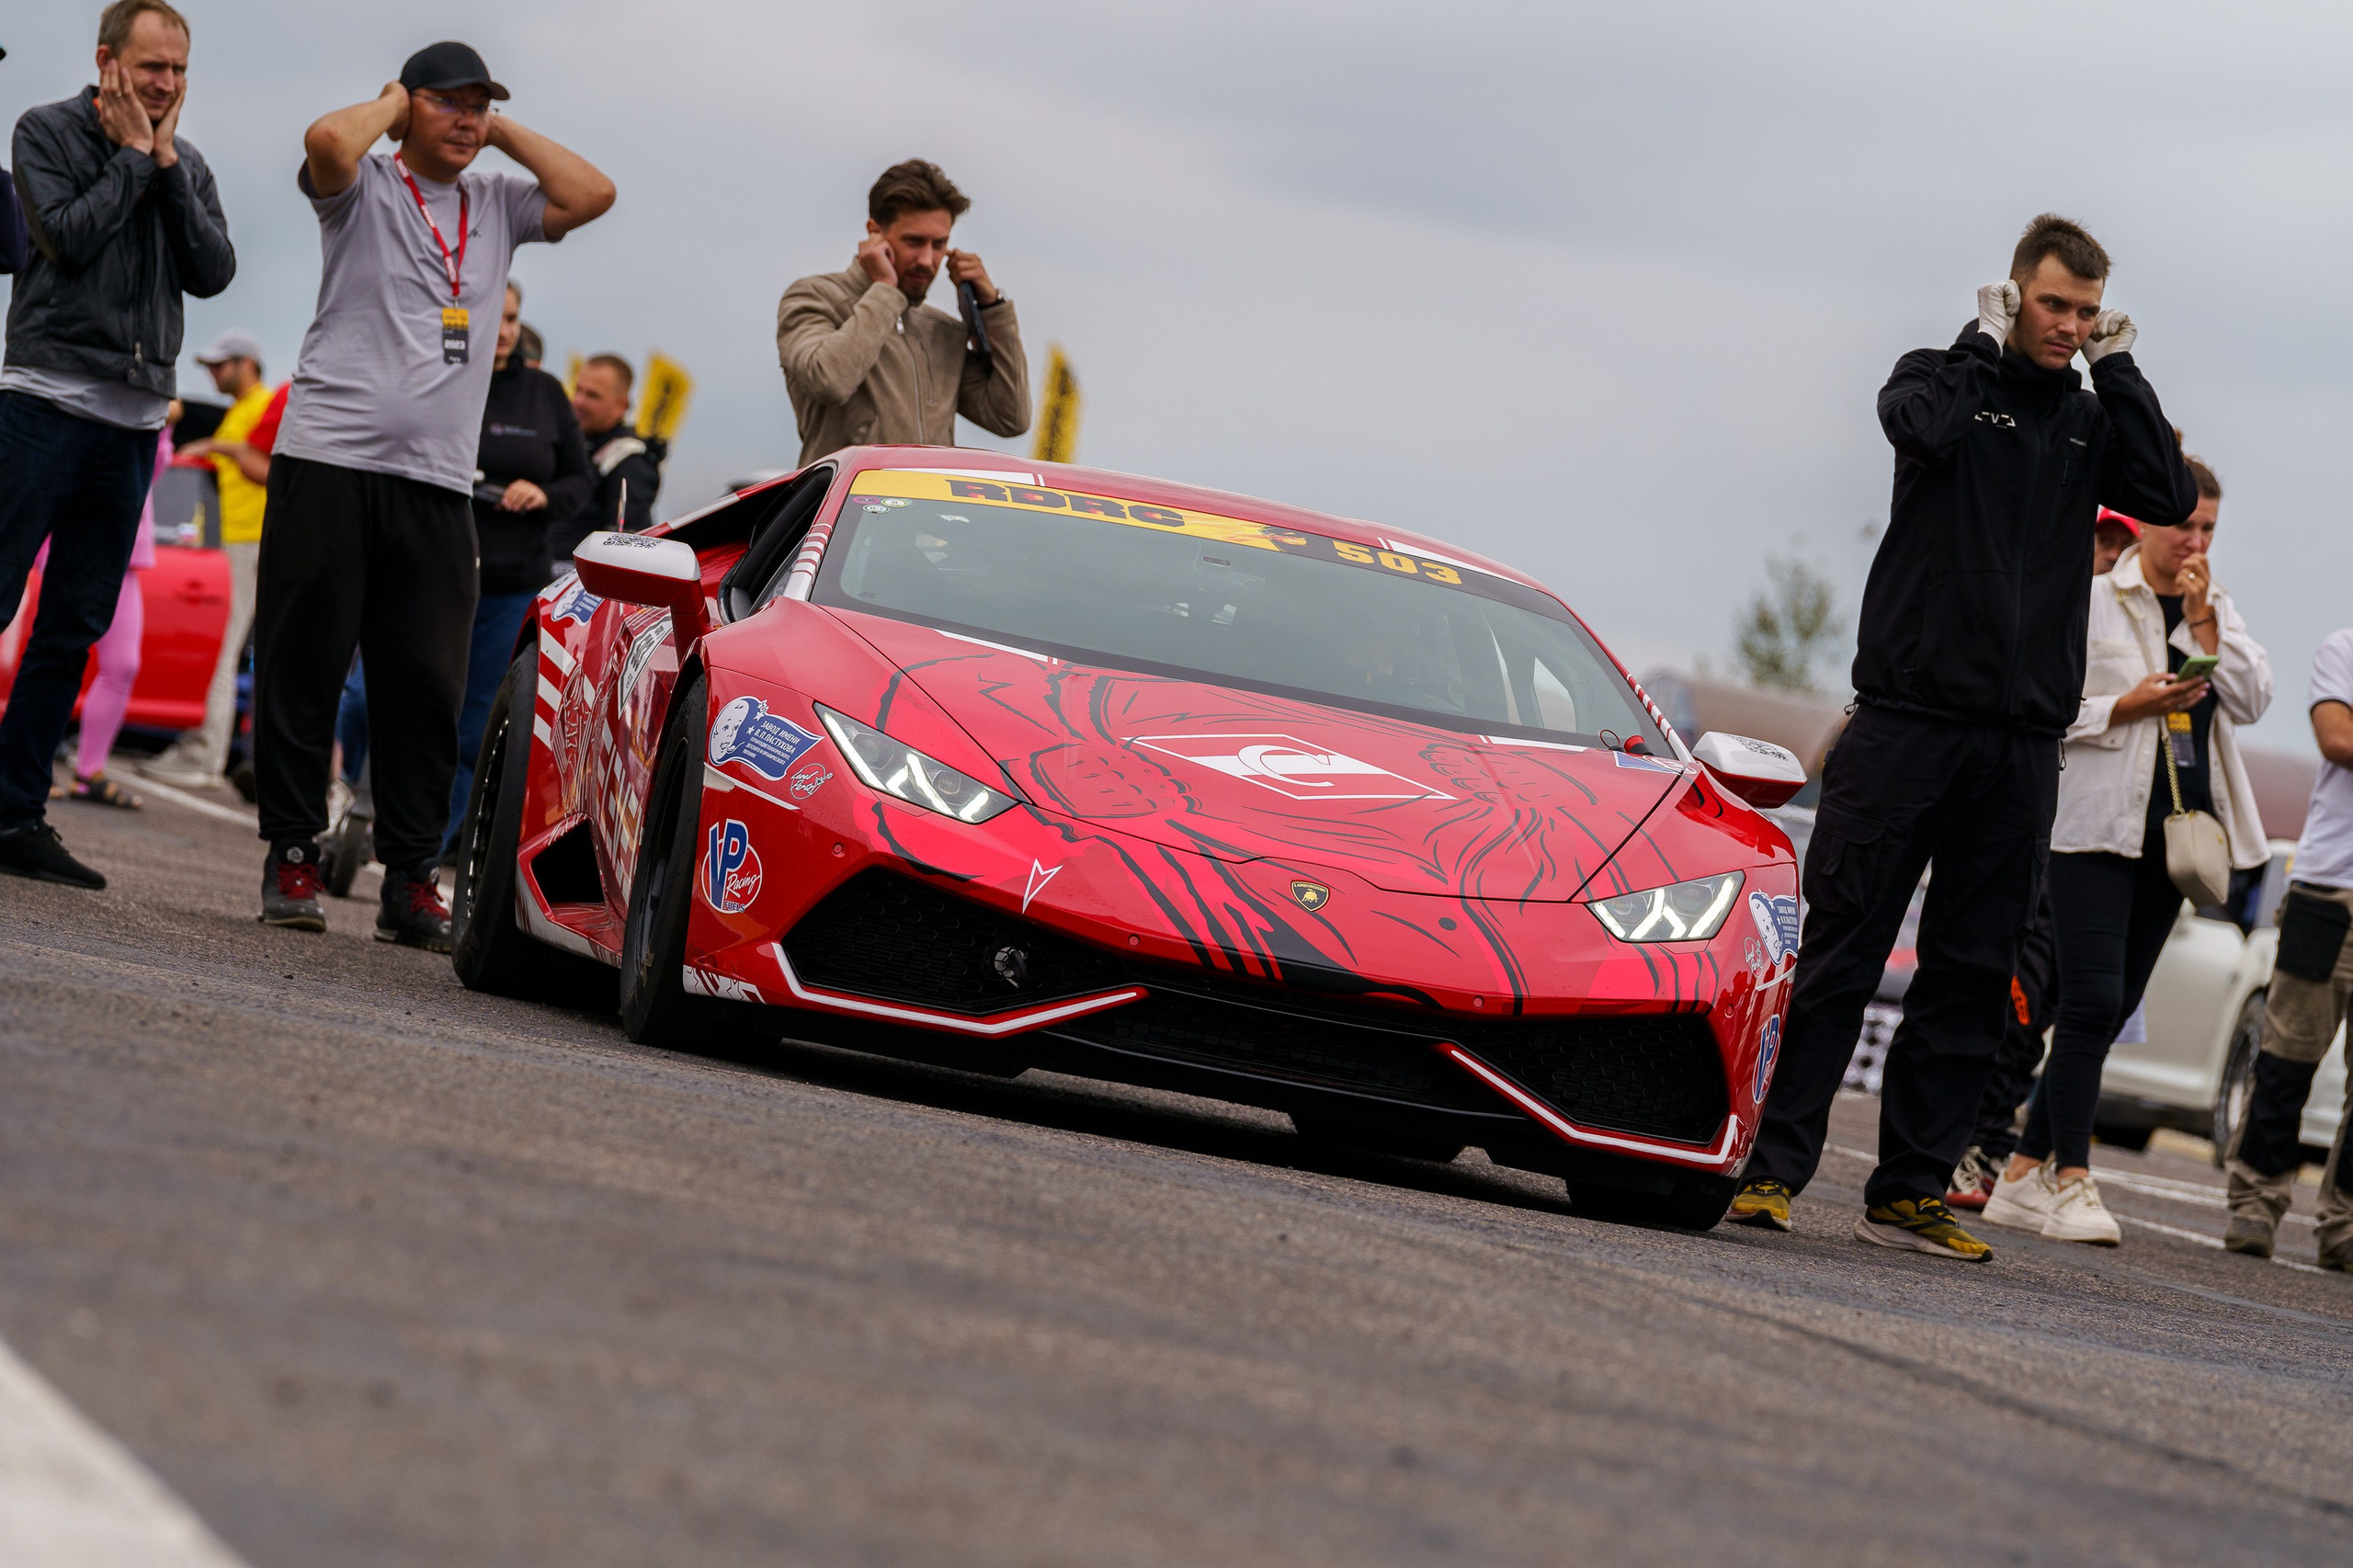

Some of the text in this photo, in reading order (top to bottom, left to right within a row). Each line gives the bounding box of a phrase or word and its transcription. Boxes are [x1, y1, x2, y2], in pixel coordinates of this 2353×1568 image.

[945, 479, 1185, 528] RDRC
[1332, 540, 1462, 585] 503
[760, 721, 801, 744] ЗАВОД ИМЕНИ
[709, 818, 749, 910] VP
[725, 871, 761, 900] Racing
[723, 900, 745, 913] FUELS
